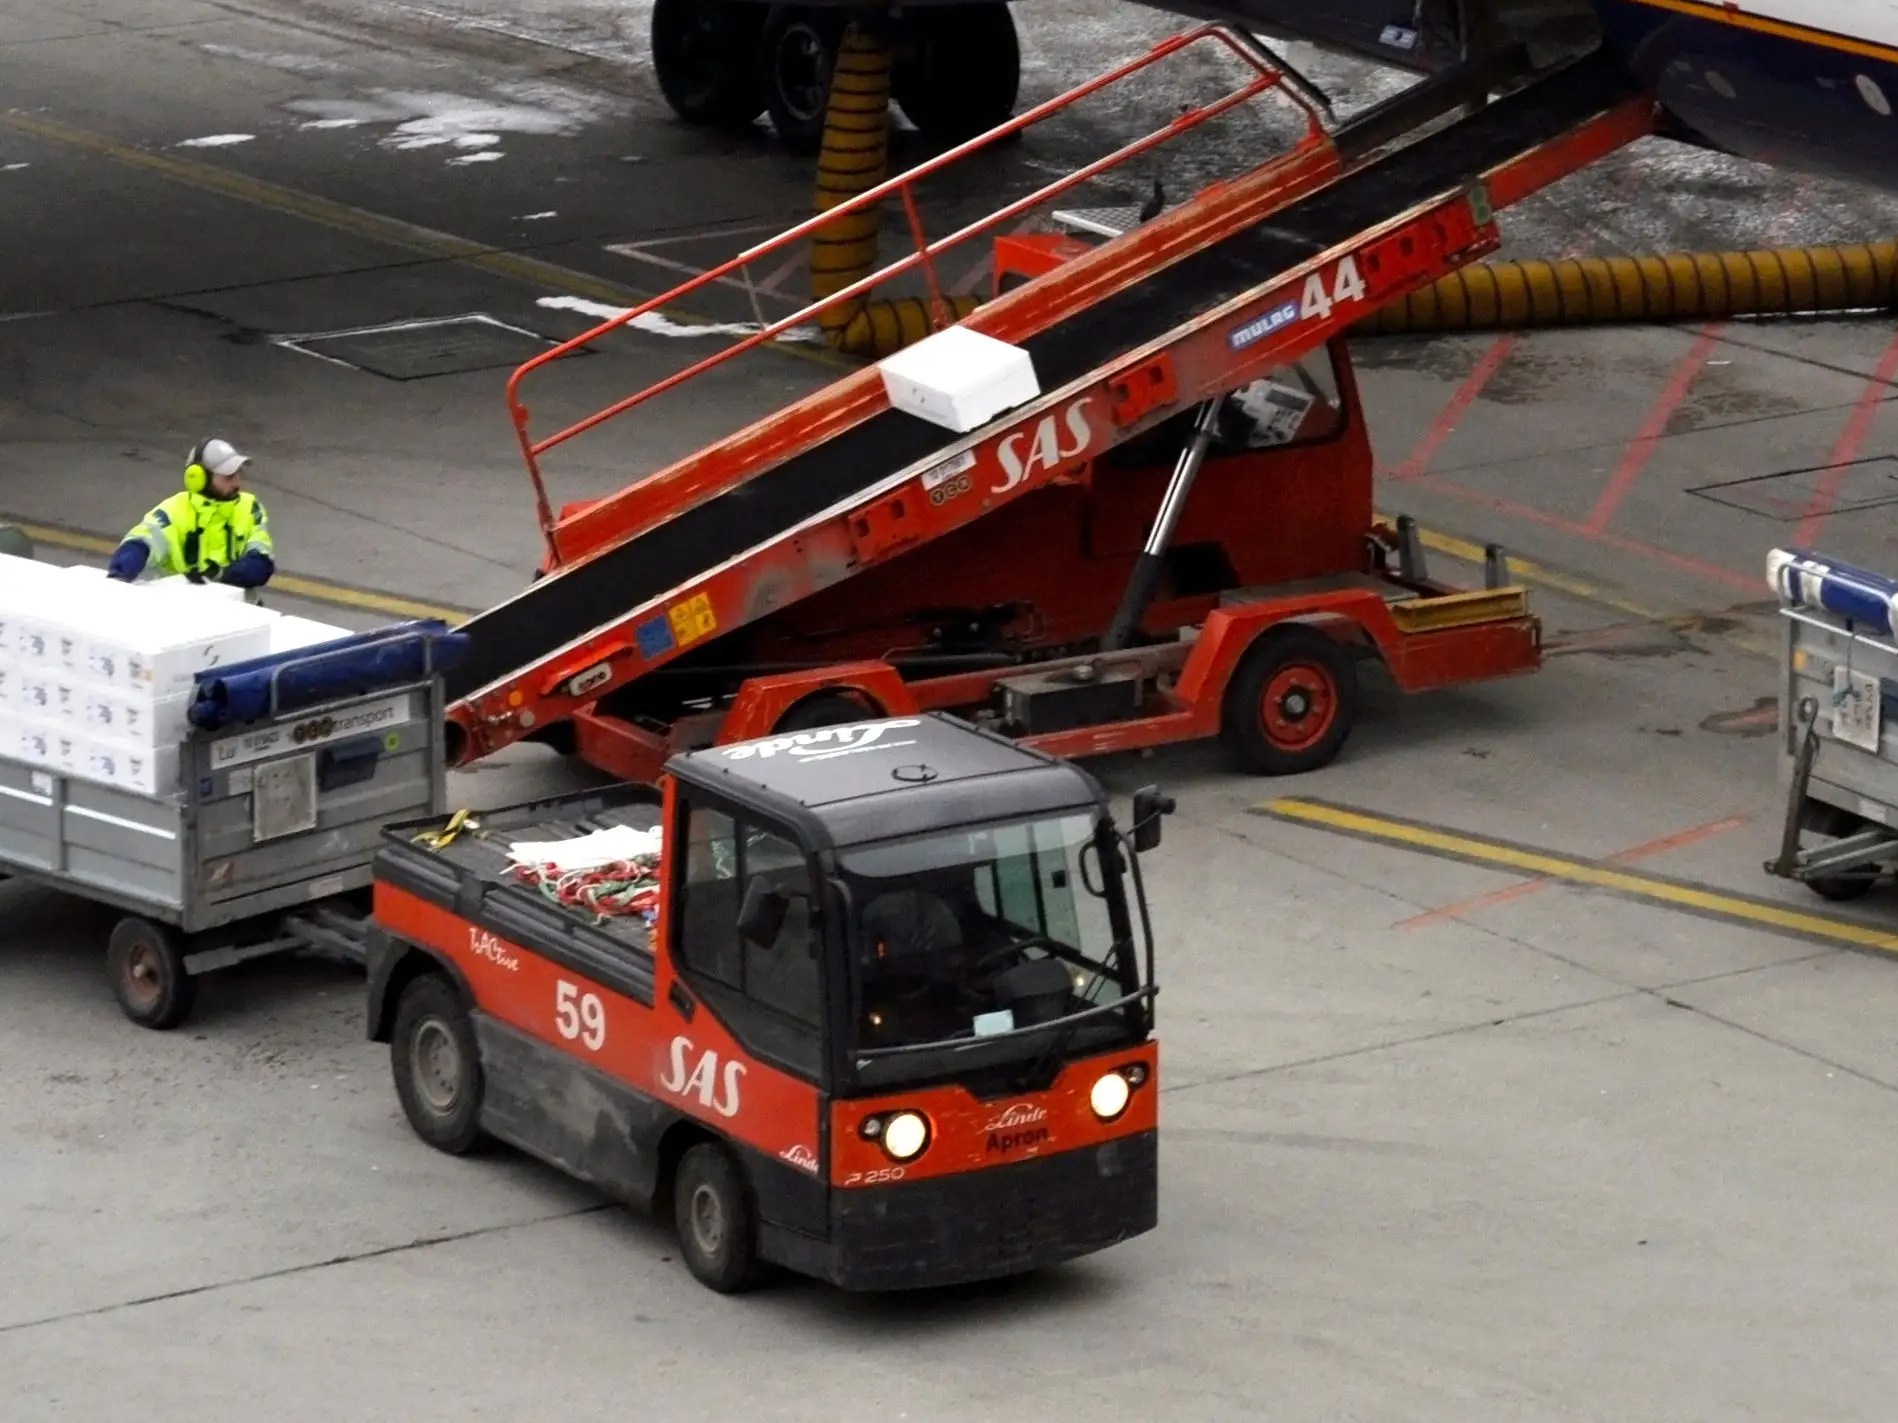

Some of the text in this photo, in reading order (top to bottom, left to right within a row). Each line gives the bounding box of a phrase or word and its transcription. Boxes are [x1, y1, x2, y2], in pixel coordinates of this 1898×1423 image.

[1301, 255, 1365, 320] 44
[991, 397, 1092, 493] SAS
[556, 980, 606, 1051] 59
[660, 1036, 748, 1117] SAS
[985, 1103, 1047, 1130] Linde
[985, 1126, 1048, 1152] Apron
